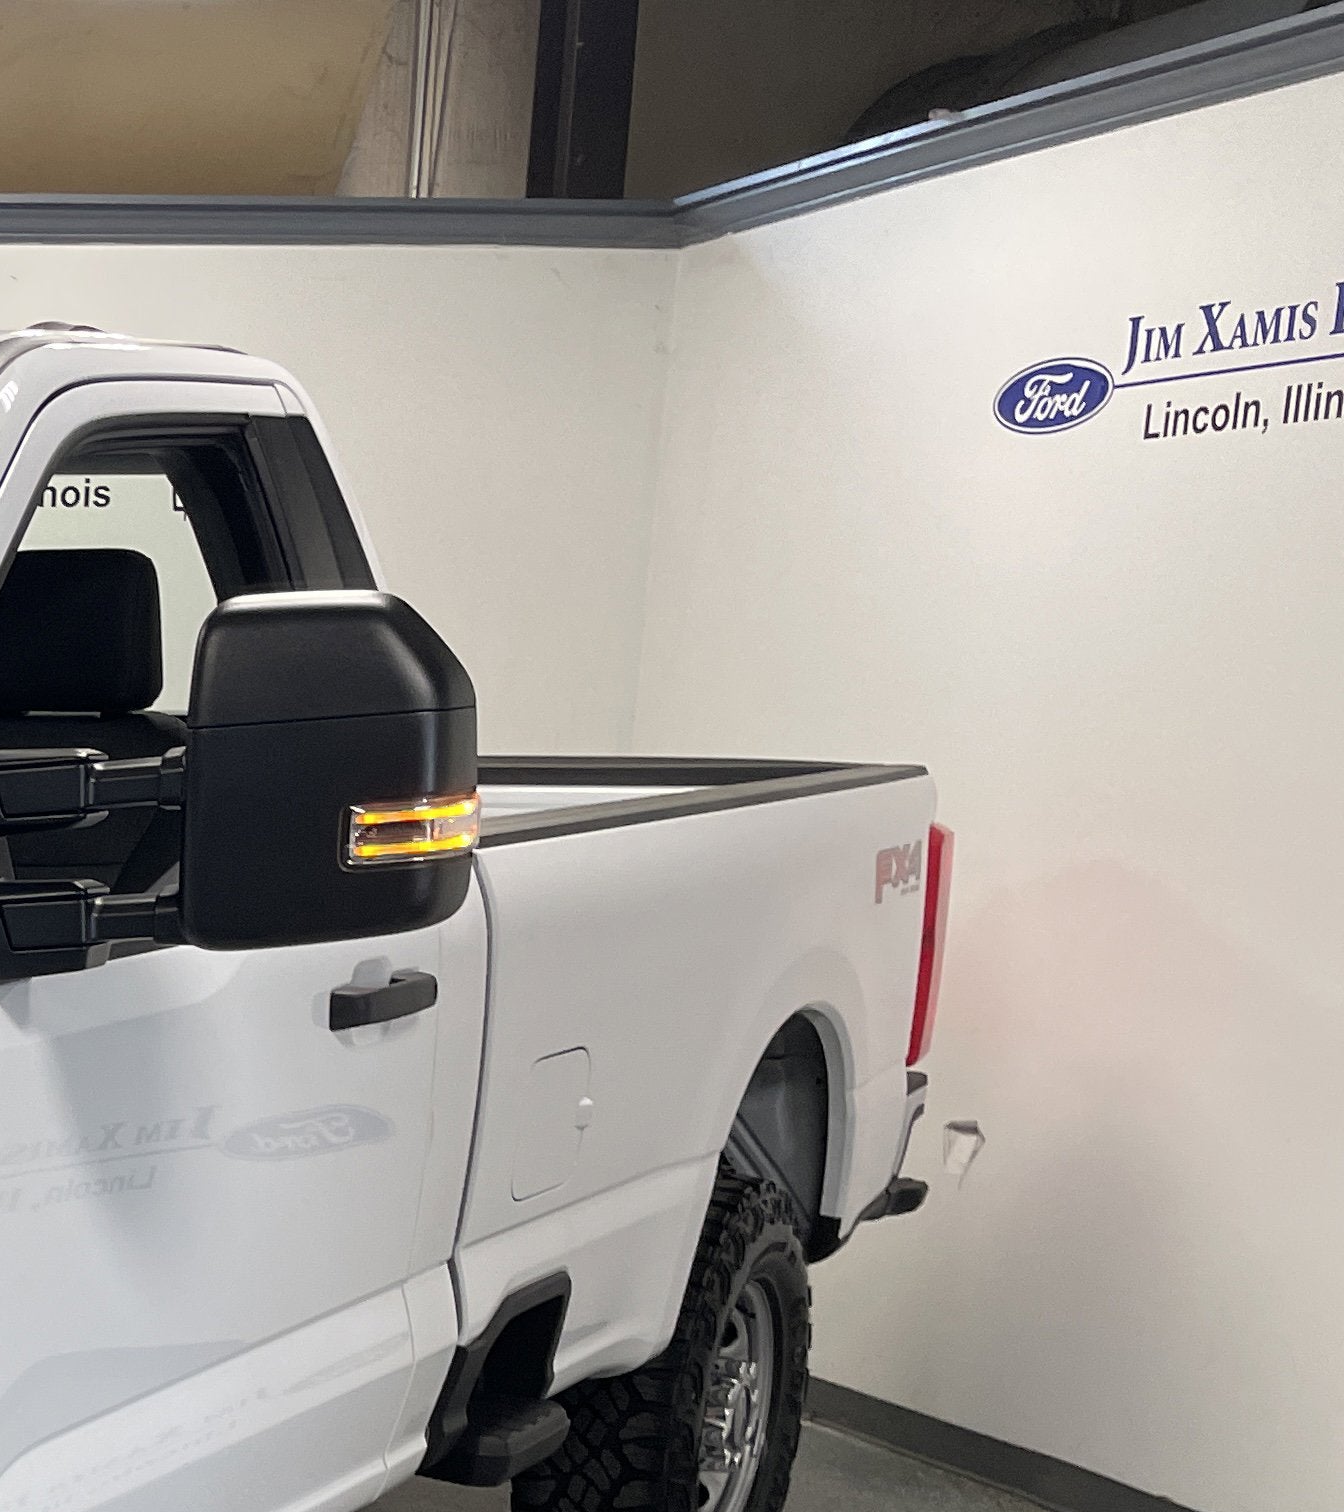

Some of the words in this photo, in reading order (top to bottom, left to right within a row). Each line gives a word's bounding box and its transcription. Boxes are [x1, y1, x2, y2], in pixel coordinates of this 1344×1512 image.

[1121, 315, 1185, 375] JIM
[1193, 300, 1319, 355] XAMIS
[1015, 372, 1091, 423] Ford
[1143, 393, 1269, 440] Lincoln,
